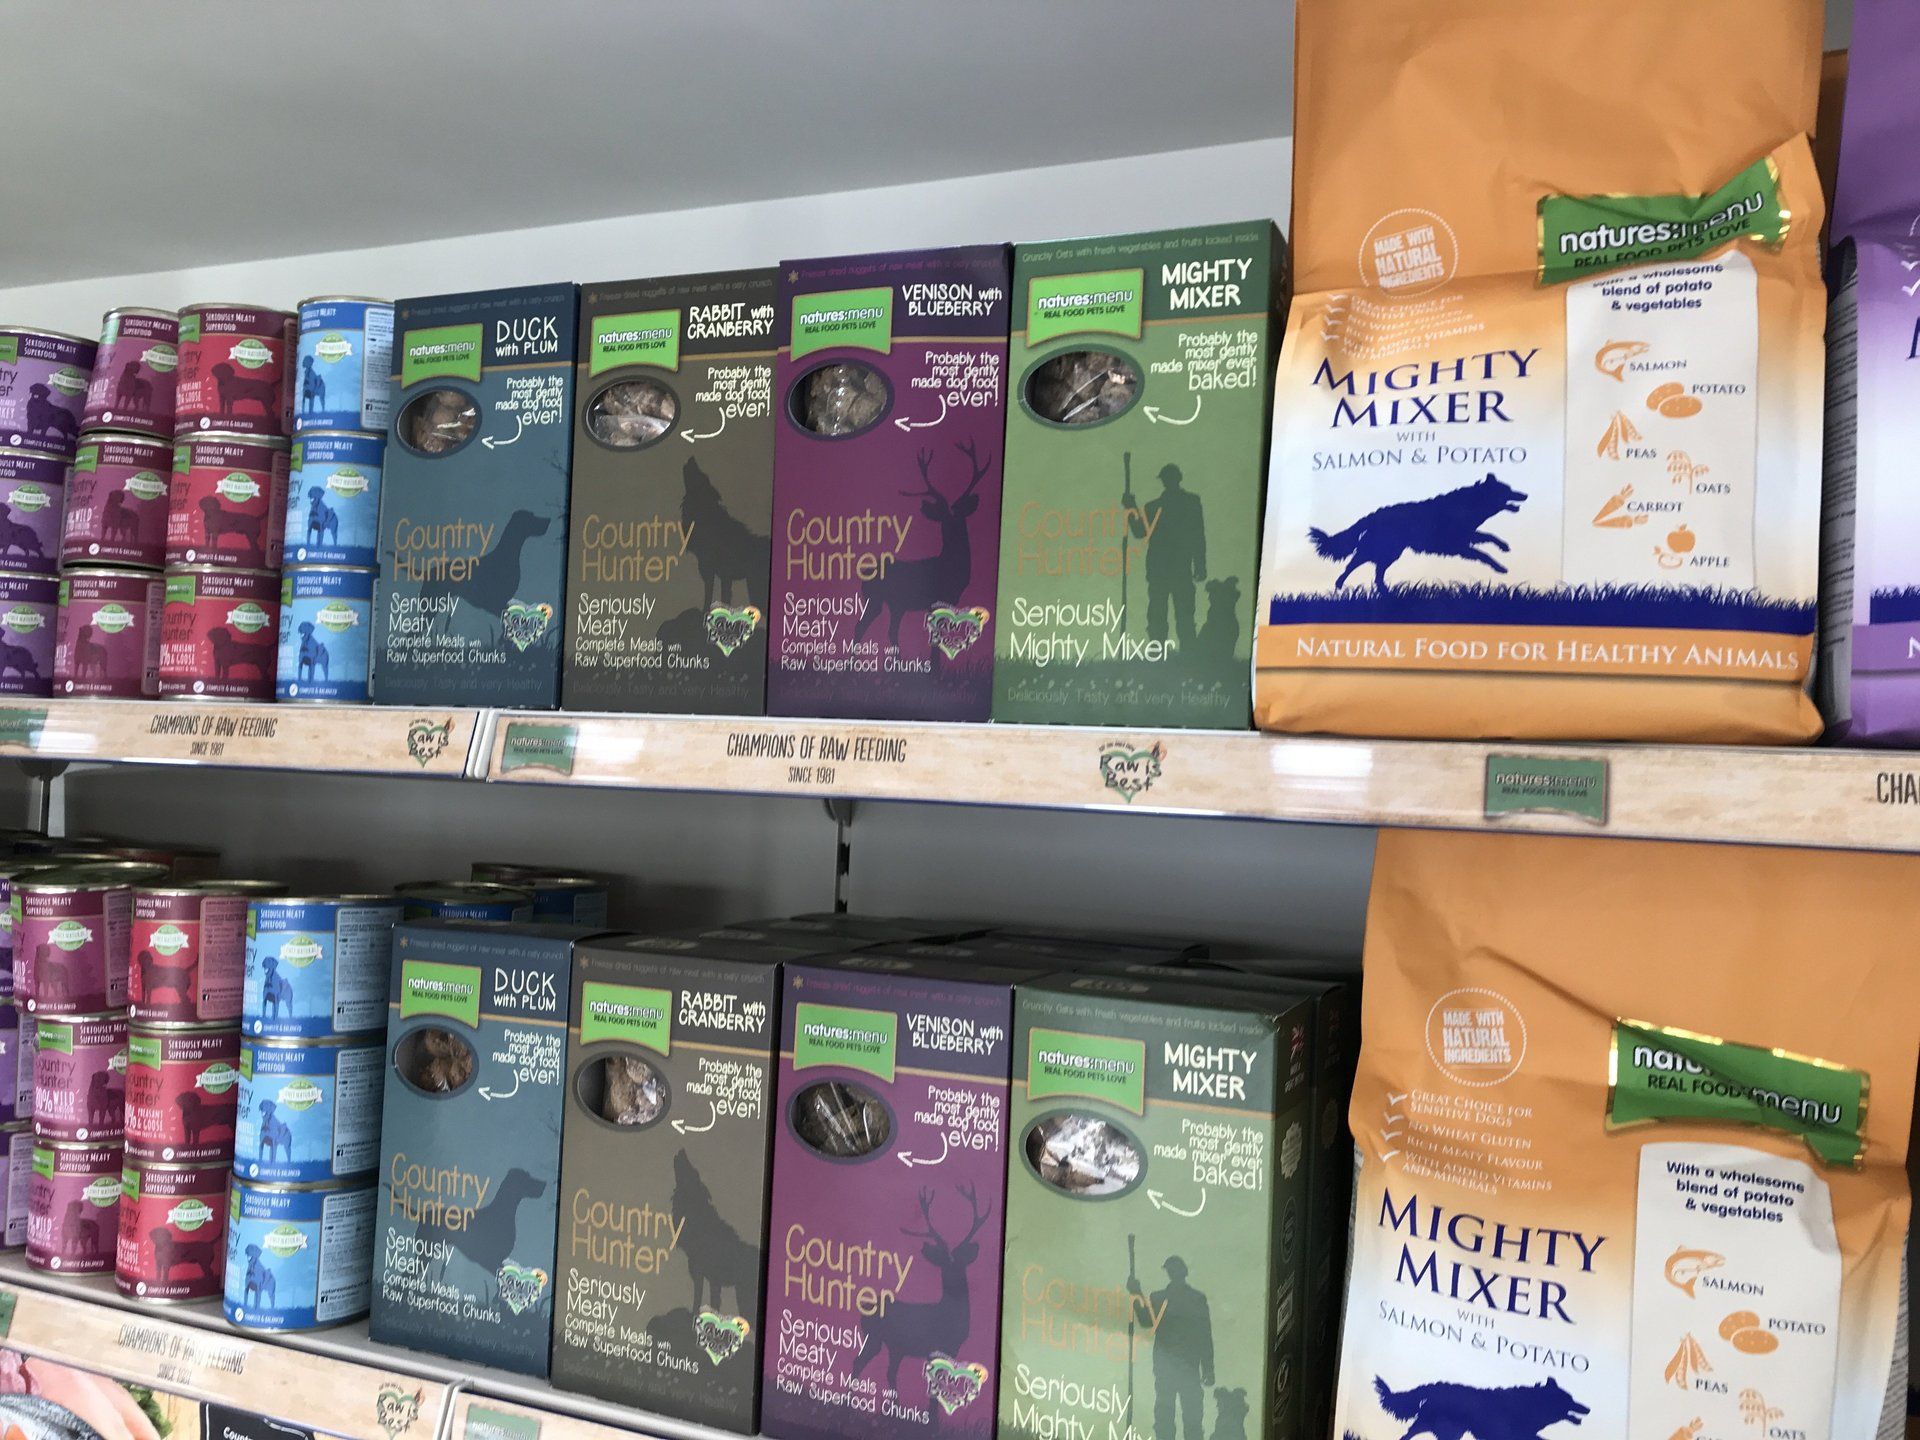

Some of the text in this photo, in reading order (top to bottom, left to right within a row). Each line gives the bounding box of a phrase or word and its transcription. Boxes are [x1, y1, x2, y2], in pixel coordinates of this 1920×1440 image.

[1162, 258, 1252, 286] MIGHTY
[902, 284, 1002, 301] VENISON with
[1170, 285, 1241, 310] MIXER
[1601, 279, 1713, 296] blend of potato
[908, 302, 993, 316] BLUEBERRY
[1038, 290, 1133, 309] natures:menu
[1612, 298, 1702, 312] & vegetables
[205, 313, 256, 324] SERIOUSLY MEATY
[690, 303, 774, 323] RABBIT with
[800, 307, 883, 325] natures:menu
[1044, 305, 1125, 318] REAL FOOD PETS LOVE
[205, 322, 236, 332] SUPERFOOD
[496, 316, 558, 343] DUCK
[598, 327, 672, 345] natures:menu
[687, 319, 774, 339] CRANBERRY
[1179, 329, 1257, 347] Probably the
[410, 341, 475, 357] natures:menu
[495, 340, 558, 357] with PLUM
[1186, 343, 1257, 361] most gently
[1151, 359, 1183, 374] made
[1188, 358, 1222, 372] mixer
[1313, 348, 1542, 396] MIGHTY
[1629, 359, 1688, 372] SALMON
[1189, 365, 1257, 391] baked!
[1692, 384, 1746, 395] POTATO
[1331, 390, 1514, 429] MIXER
[1312, 445, 1527, 472] SALMON & POTATO
[1626, 448, 1657, 458] PEAS
[1696, 483, 1731, 494] OATS
[1627, 501, 1683, 512] CARROT
[583, 514, 695, 556] Country
[787, 508, 912, 553] Country
[582, 548, 678, 582] Hunter
[787, 544, 894, 581] Hunter
[1690, 555, 1730, 568] APPLE
[784, 592, 869, 621] Seriously
[1012, 597, 1125, 632] Seriously
[783, 616, 839, 642] Meaty
[781, 639, 899, 656] Complete Meals with
[1010, 632, 1175, 667] Mighty Mixer
[1296, 637, 1799, 670] NATURAL FOOD FOR HEALTHY ANIMALS
[781, 656, 931, 674] Raw Superfood Chunks
[150, 715, 278, 737] CHAMPIONS OF RAW FEEDING
[407, 728, 449, 748] Raw is
[190, 742, 224, 755] SINCE 1981
[409, 743, 441, 759] Best
[727, 733, 907, 764] CHAMPIONS OF RAW FEEDING
[788, 767, 835, 784] SINCE 1981
[1100, 754, 1162, 780] Raw is
[1105, 772, 1154, 792] Best
[495, 967, 556, 996] DUCK
[494, 994, 556, 1012] with PLUM
[681, 990, 766, 1016] RABBIT with
[679, 1010, 765, 1033] CRANBERRY
[907, 1013, 1003, 1040] VENISON with
[1476, 1011, 1504, 1025] WITH
[168, 1038, 222, 1050] SERIOUSLY MEATY
[913, 1032, 995, 1055] BLUEBERRY
[1443, 1027, 1509, 1048] NATURAL
[168, 1049, 202, 1060] SUPERFOOD
[257, 1051, 305, 1062] SERIOUSLY MEATY
[1165, 1041, 1257, 1074] MIGHTY
[257, 1062, 285, 1072] SUPERFOOD
[1172, 1069, 1246, 1101] MIXER
[1648, 1075, 1686, 1093] REAL
[1411, 1089, 1533, 1118] GREAT CHOICE FOR
[1410, 1102, 1513, 1128] SENSITIVE DOGS
[1433, 1125, 1476, 1142] WHEAT
[1481, 1133, 1531, 1149] GLUTEN
[1407, 1136, 1543, 1170] RICH MEATY FLAVOUR
[391, 1152, 491, 1209] Country
[1403, 1164, 1497, 1195] AND MINERALS
[1493, 1172, 1552, 1191] VITAMINS
[1667, 1160, 1805, 1194] With a wholesome
[1677, 1179, 1794, 1207] blend of potato
[389, 1183, 475, 1232] Hunter
[1685, 1199, 1783, 1223] & vegetables
[1378, 1186, 1609, 1274] MIGHTY
[1396, 1242, 1577, 1325] MIXER
[1702, 1276, 1764, 1296] SALMON
[1457, 1308, 1495, 1329] WITH
[1769, 1318, 1826, 1335] POTATO
[119, 1323, 182, 1355] CHAMPIONS OF
[1379, 1300, 1590, 1374] SALMON & POTATO
[1696, 1379, 1729, 1394] PEAS
[1770, 1427, 1806, 1440] OATS
